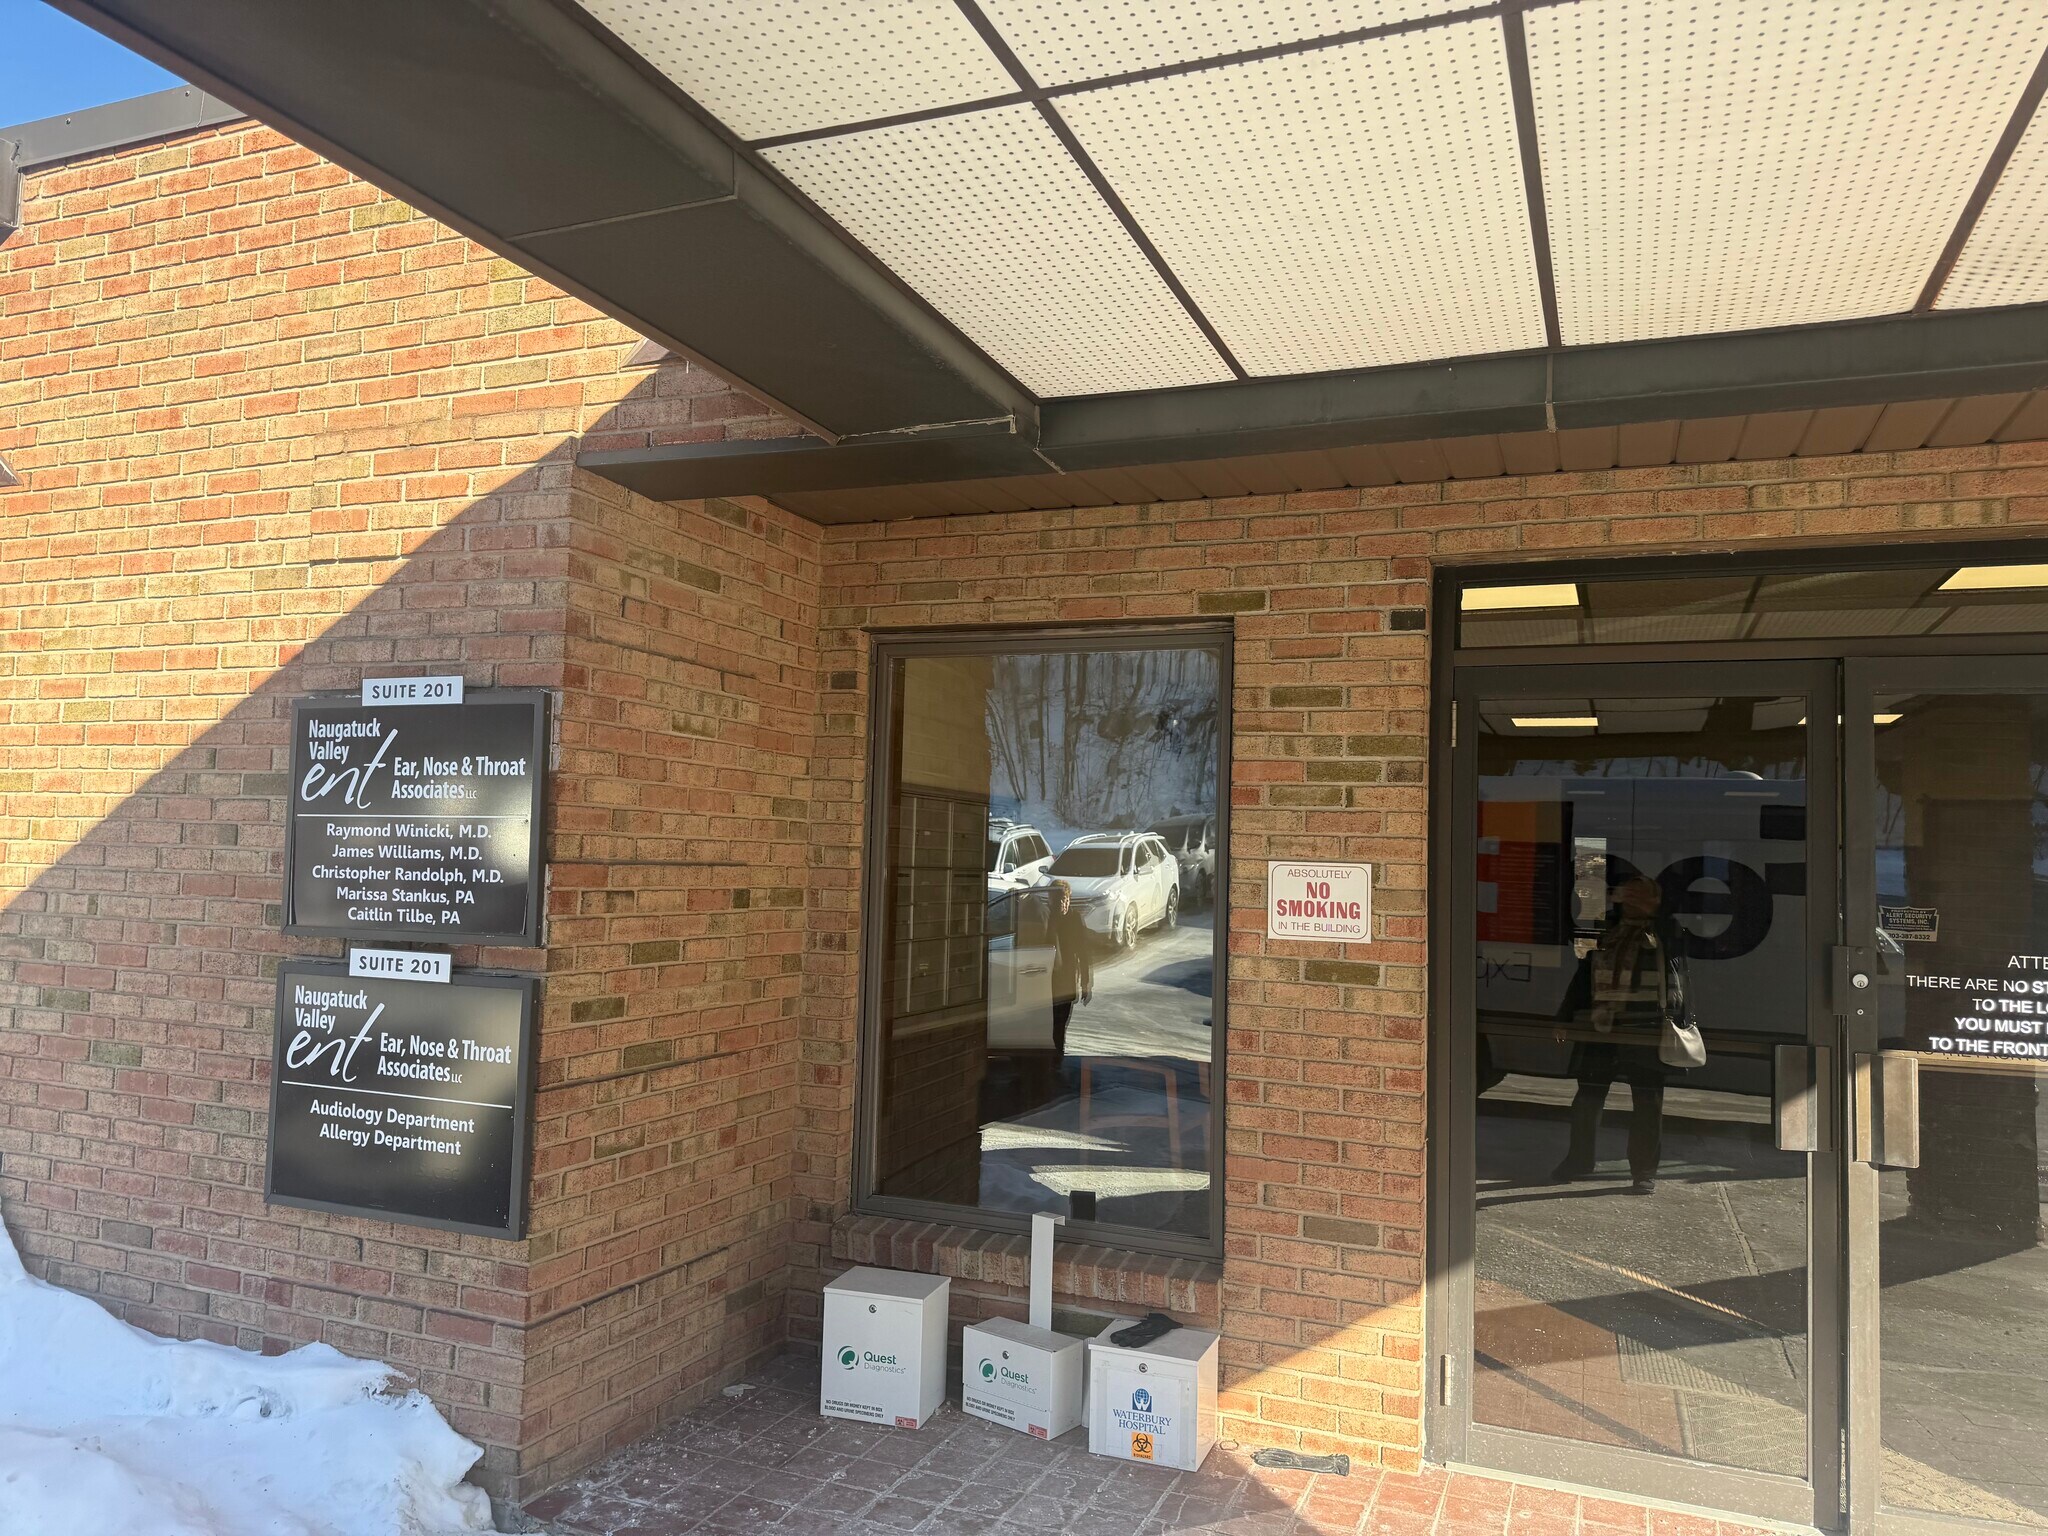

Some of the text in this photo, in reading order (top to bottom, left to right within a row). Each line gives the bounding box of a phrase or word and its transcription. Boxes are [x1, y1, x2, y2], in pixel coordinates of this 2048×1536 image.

[372, 683, 453, 699] SUITE 201
[309, 718, 381, 742] Naugatuck
[309, 741, 349, 764] Valley
[301, 728, 399, 809] ent
[394, 756, 526, 780] Ear, Nose & Throat
[391, 780, 477, 799] Associates LLC
[327, 823, 492, 840] Raymond Winicki, M.D.
[332, 845, 483, 861] James Williams, M.D.
[312, 865, 504, 885] Christopher Randolph, M.D.
[1287, 869, 1352, 879] ABSOLUTELY
[337, 887, 475, 905] Marissa Stankus, PA
[1306, 882, 1331, 899] NO
[348, 907, 460, 925] Caitlin Tilbe, PA
[1276, 899, 1361, 920] SMOKING
[1278, 921, 1361, 933] IN THE BUILDING
[359, 955, 441, 975] SUITE 201
[1906, 975, 1961, 990] THERE
[1965, 978, 1998, 992] ARE
[2003, 980, 2029, 994] NO
[295, 985, 368, 1011] Naugatuck
[1972, 998, 2048, 1015] TO THE L
[295, 1008, 336, 1035] Valley
[1954, 1017, 1990, 1031] YOU
[1994, 1019, 2043, 1034] MUST
[286, 1002, 385, 1083] ent
[380, 1032, 512, 1064] Ear, Nose & Throat
[1929, 1036, 2048, 1056] TO THE FRONT
[377, 1056, 463, 1084] Associates LLC
[310, 1099, 475, 1133] Audiology Department
[319, 1123, 462, 1155] Allergy Department
[864, 1351, 897, 1365] Quest
[1001, 1366, 1029, 1384] Quest
[1112, 1409, 1172, 1427] WATERBURY
[1118, 1419, 1166, 1435] HOSPITAL
